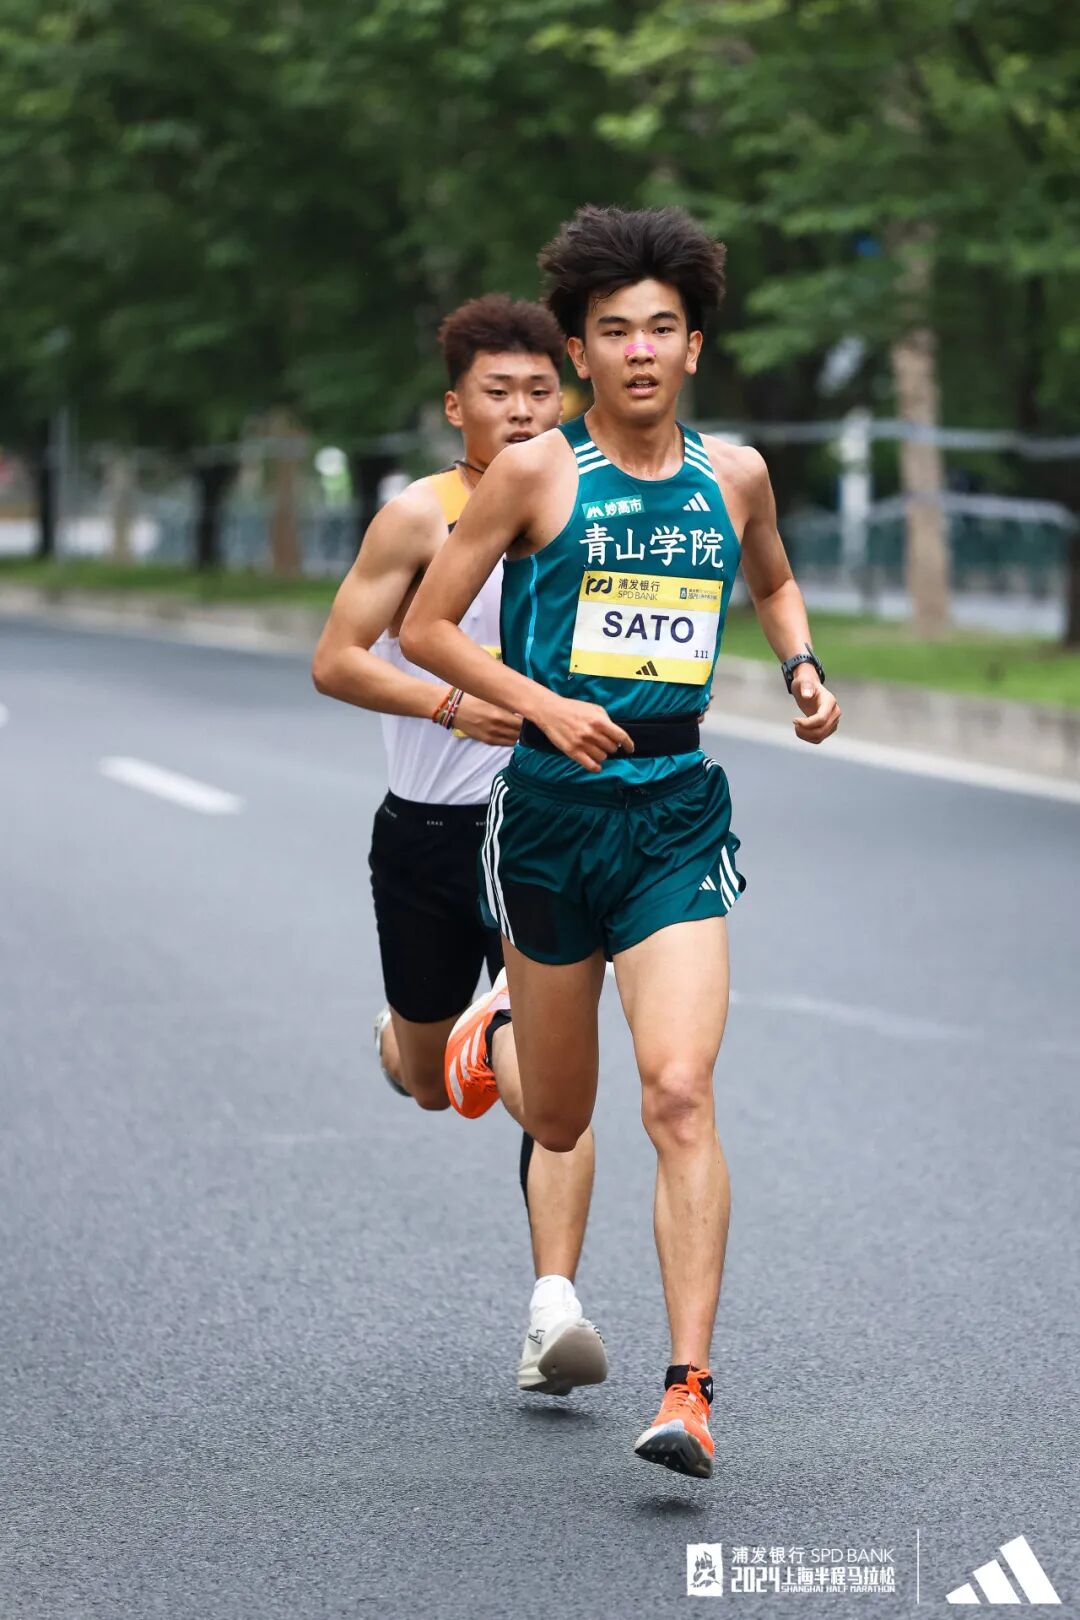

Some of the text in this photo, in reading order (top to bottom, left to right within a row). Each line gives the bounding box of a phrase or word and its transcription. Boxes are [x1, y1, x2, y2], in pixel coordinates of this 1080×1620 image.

[604, 499, 642, 517] 妙高市
[579, 523, 724, 568] 青山学院
[618, 578, 660, 592] 浦发银行
[618, 590, 658, 601] SPD BANK
[602, 610, 694, 643] SATO
[694, 650, 709, 658] 111
